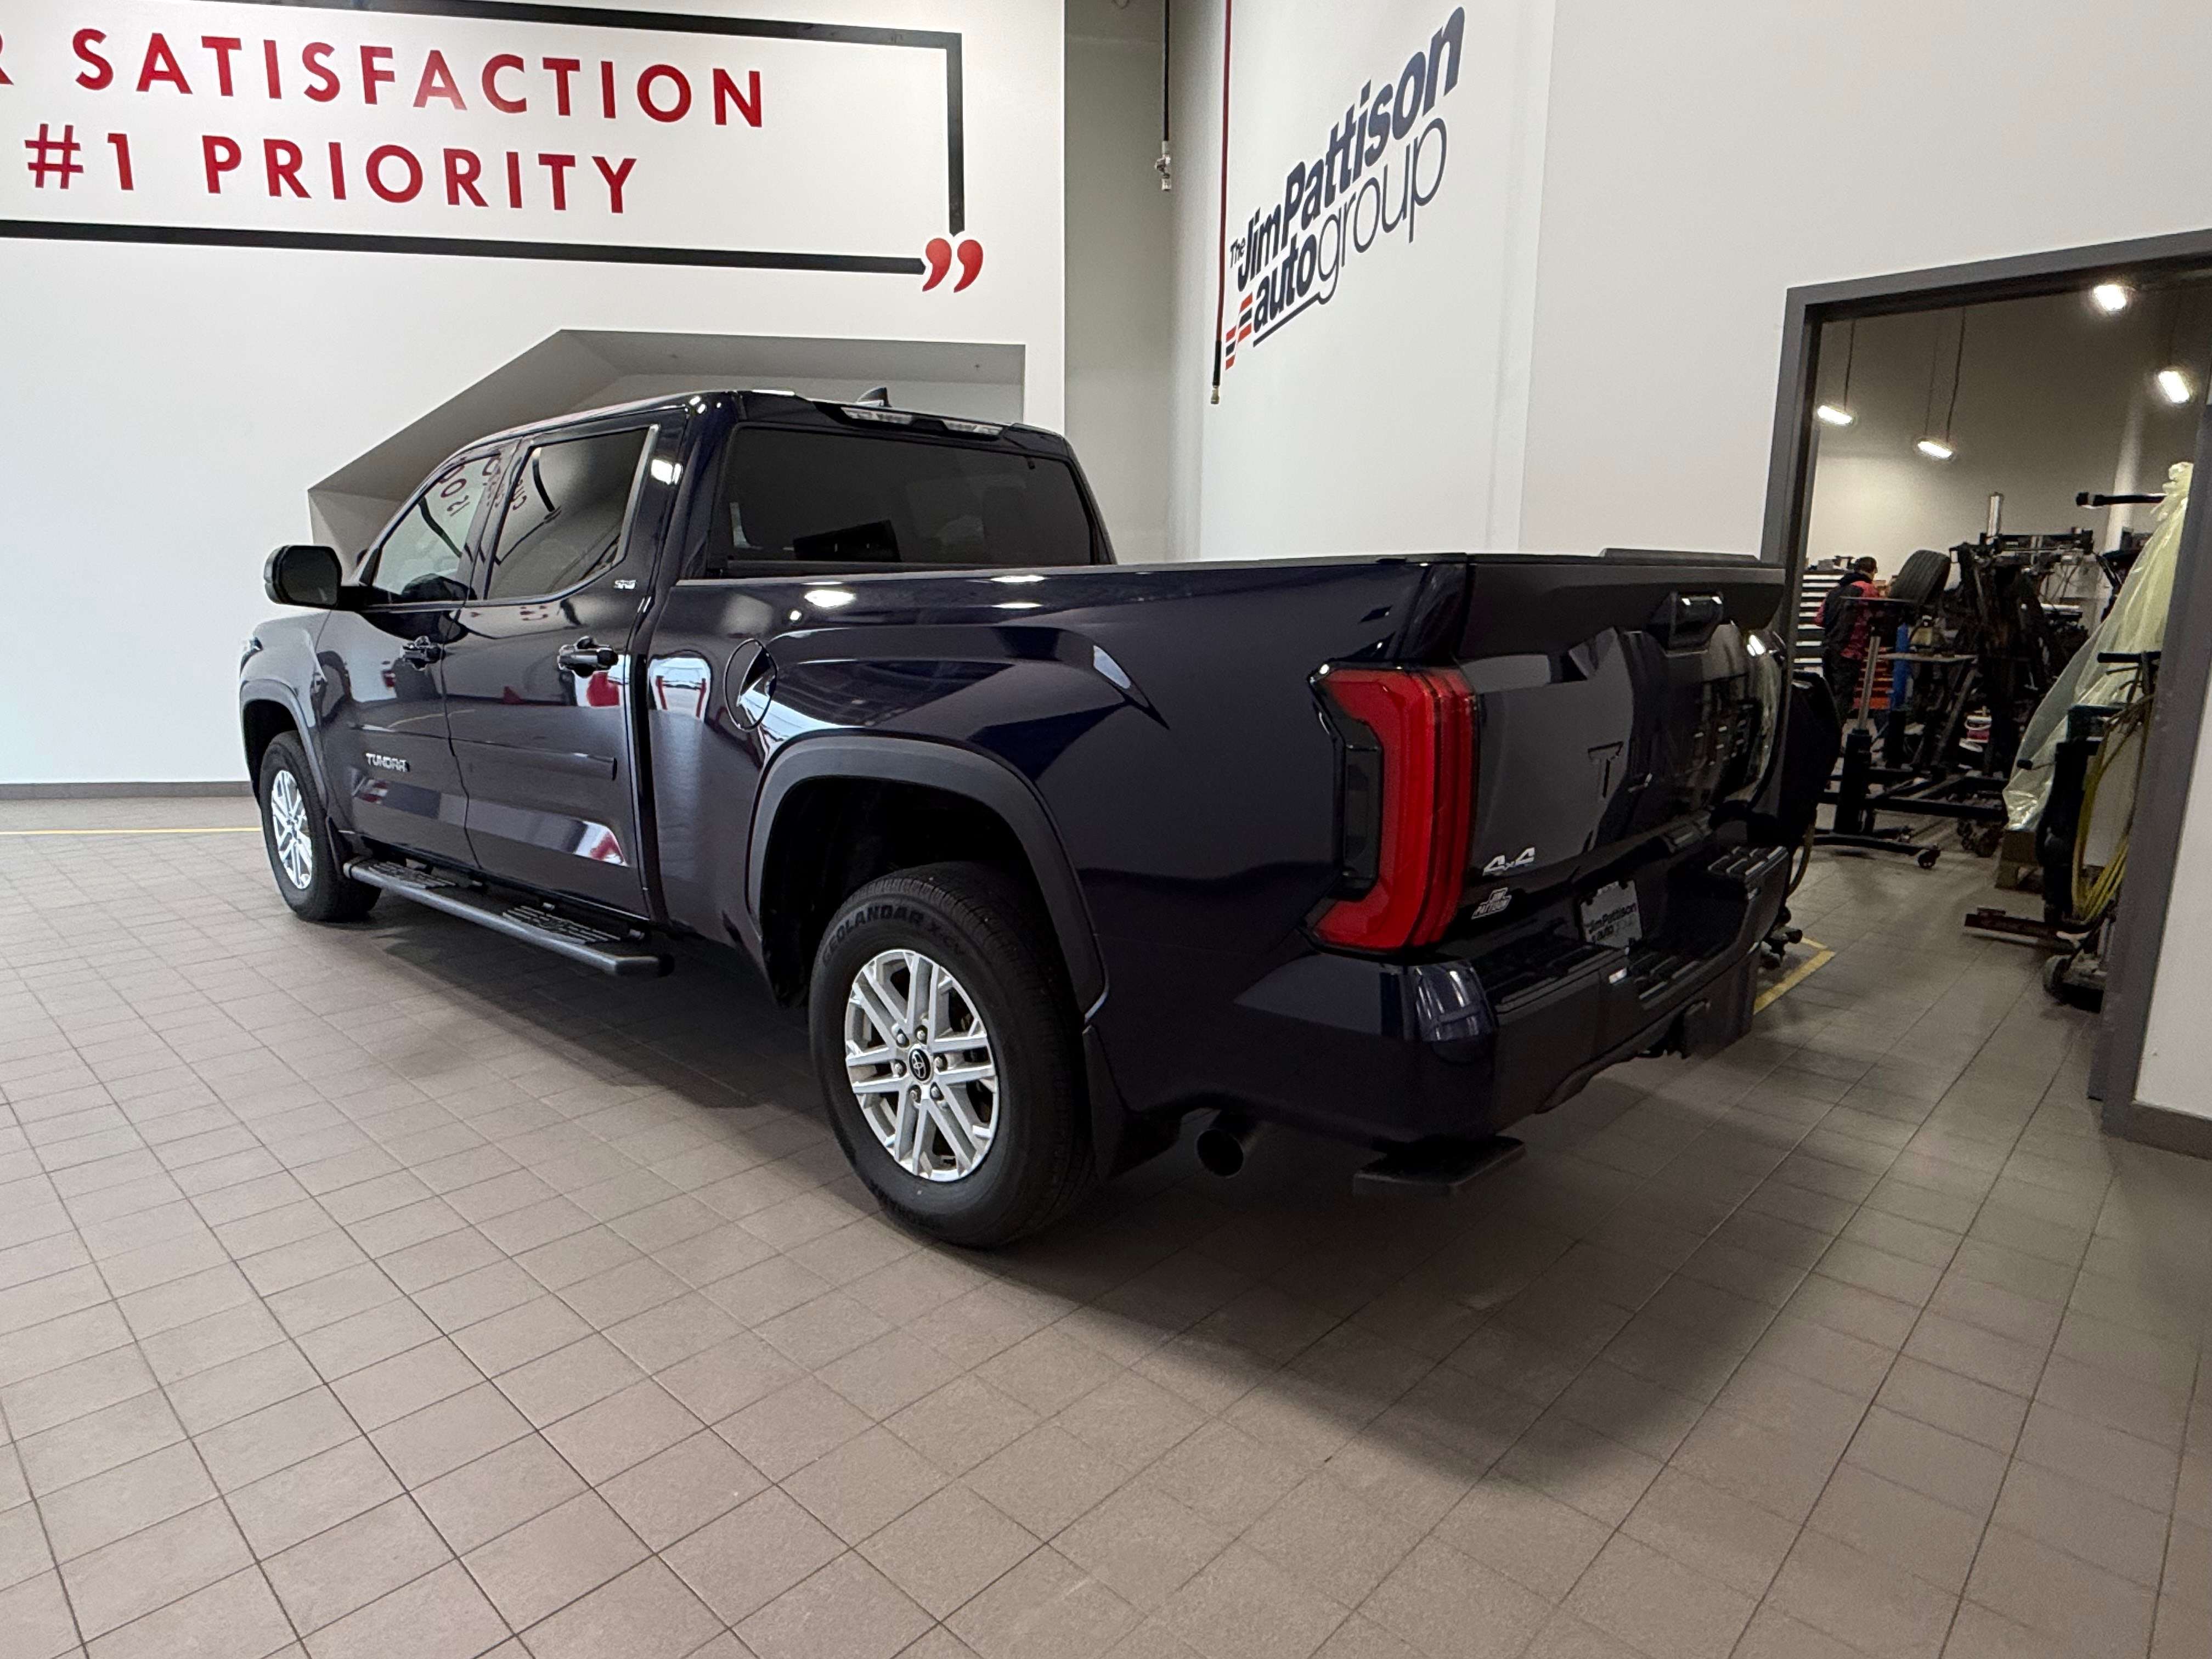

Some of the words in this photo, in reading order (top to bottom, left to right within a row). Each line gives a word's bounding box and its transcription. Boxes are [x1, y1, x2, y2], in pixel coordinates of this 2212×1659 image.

[72, 27, 763, 128] SATISFACTION
[25, 123, 133, 190] #1
[202, 134, 636, 214] PRIORITY
[1229, 237, 1245, 268] The
[365, 753, 407, 772] TUNDRA
[822, 905, 924, 966] GEOLANDAR
